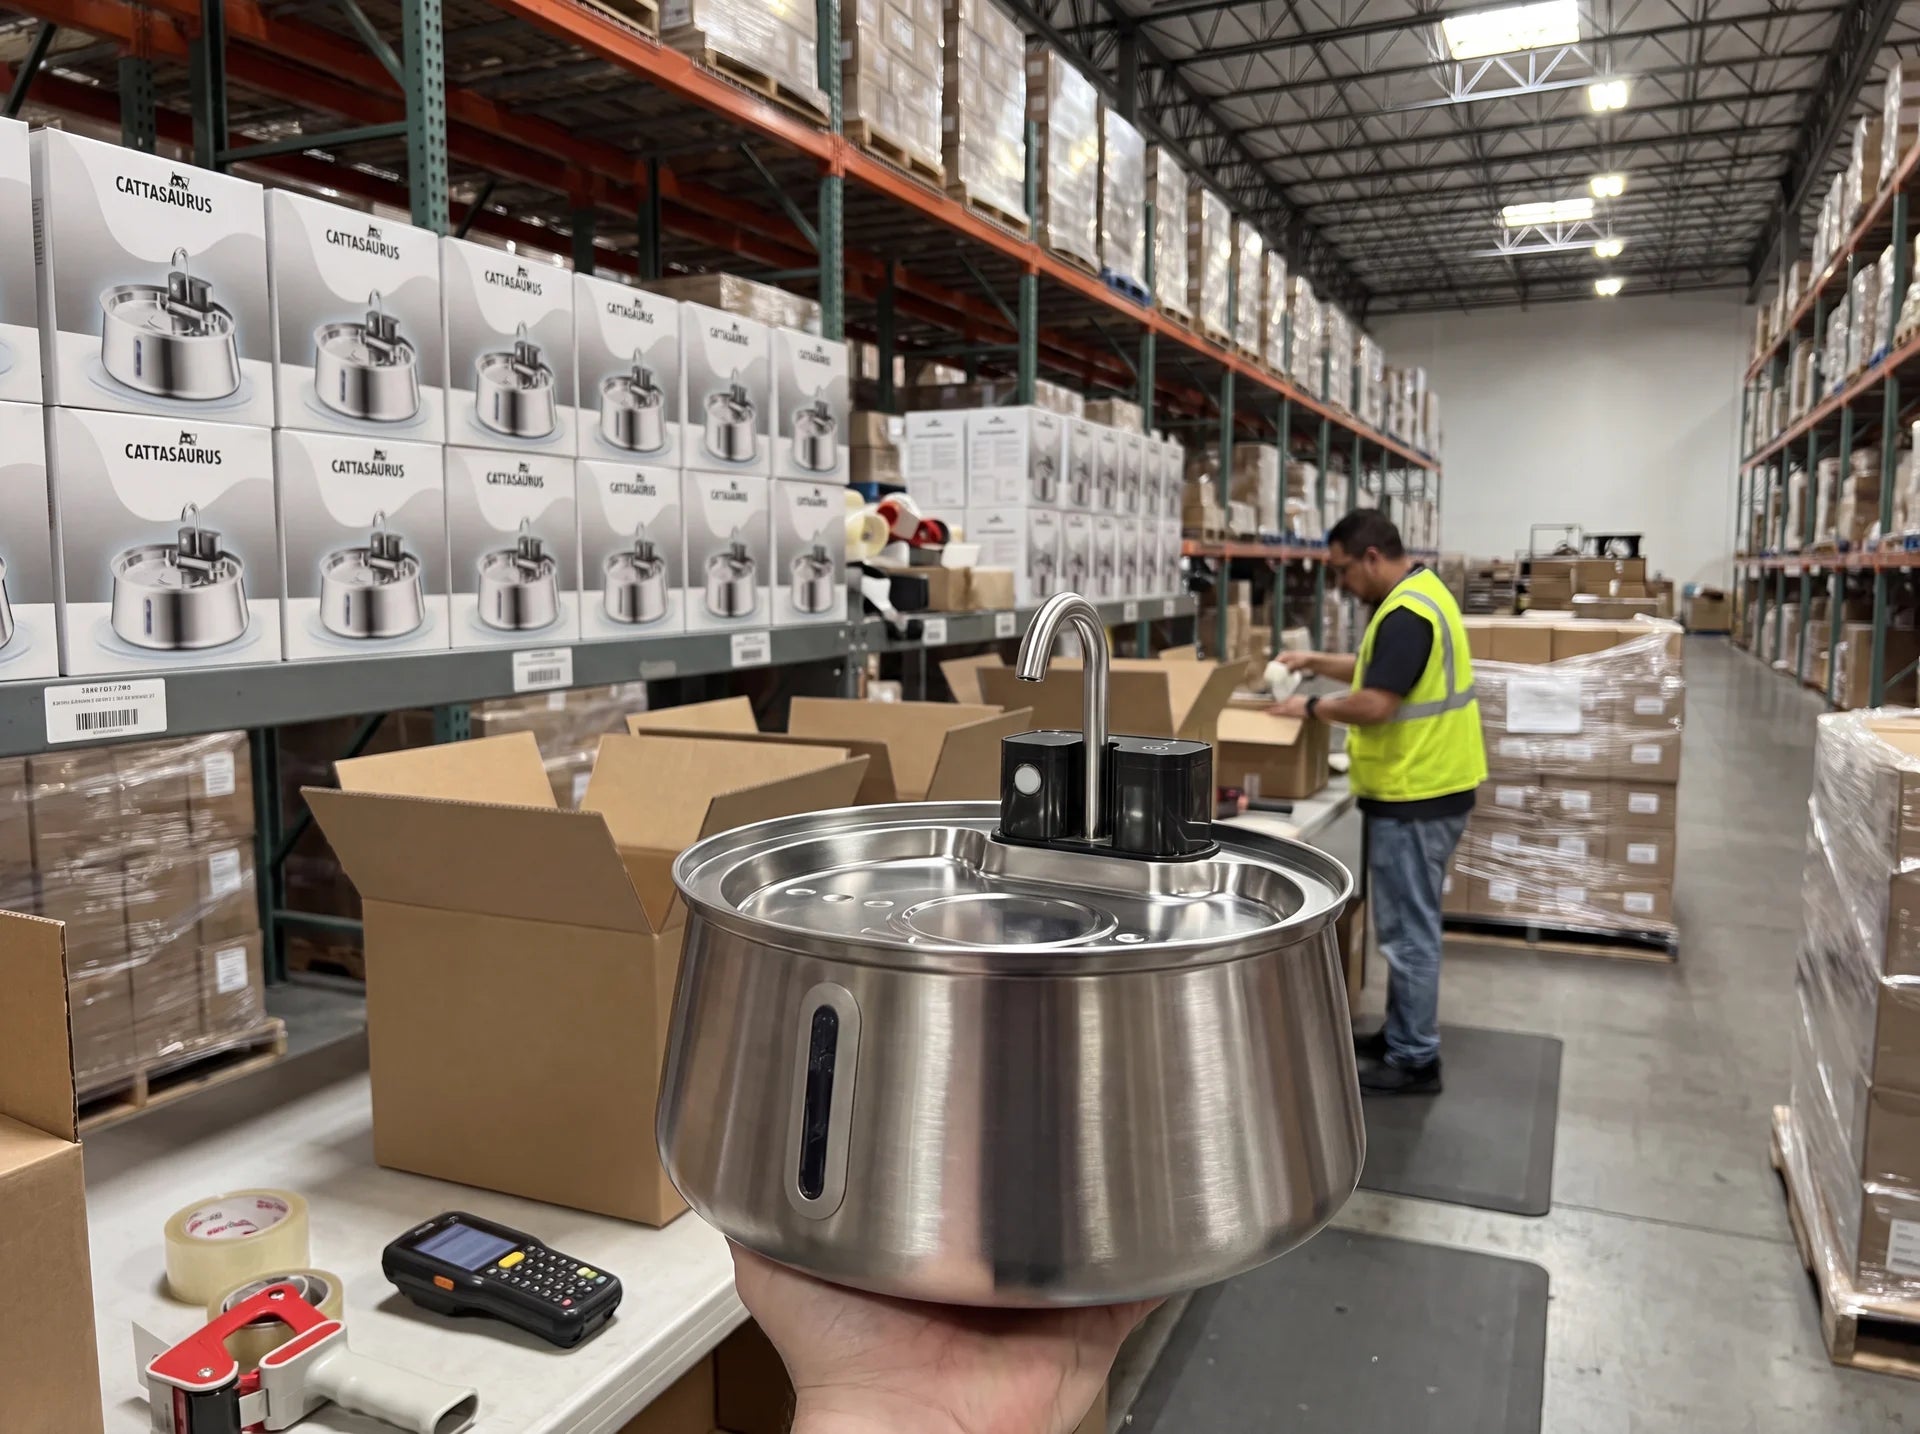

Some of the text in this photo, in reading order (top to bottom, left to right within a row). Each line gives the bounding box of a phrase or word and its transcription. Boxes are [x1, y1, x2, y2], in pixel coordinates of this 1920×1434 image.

[115, 175, 213, 215] CATTASAURUS
[326, 229, 400, 260] CATTASAURUS
[484, 271, 543, 296] CATTASAURUS
[124, 443, 222, 465] CATTASAURUS
[331, 459, 405, 478] CATTASAURUS
[486, 472, 544, 489] CATTASAURUS
